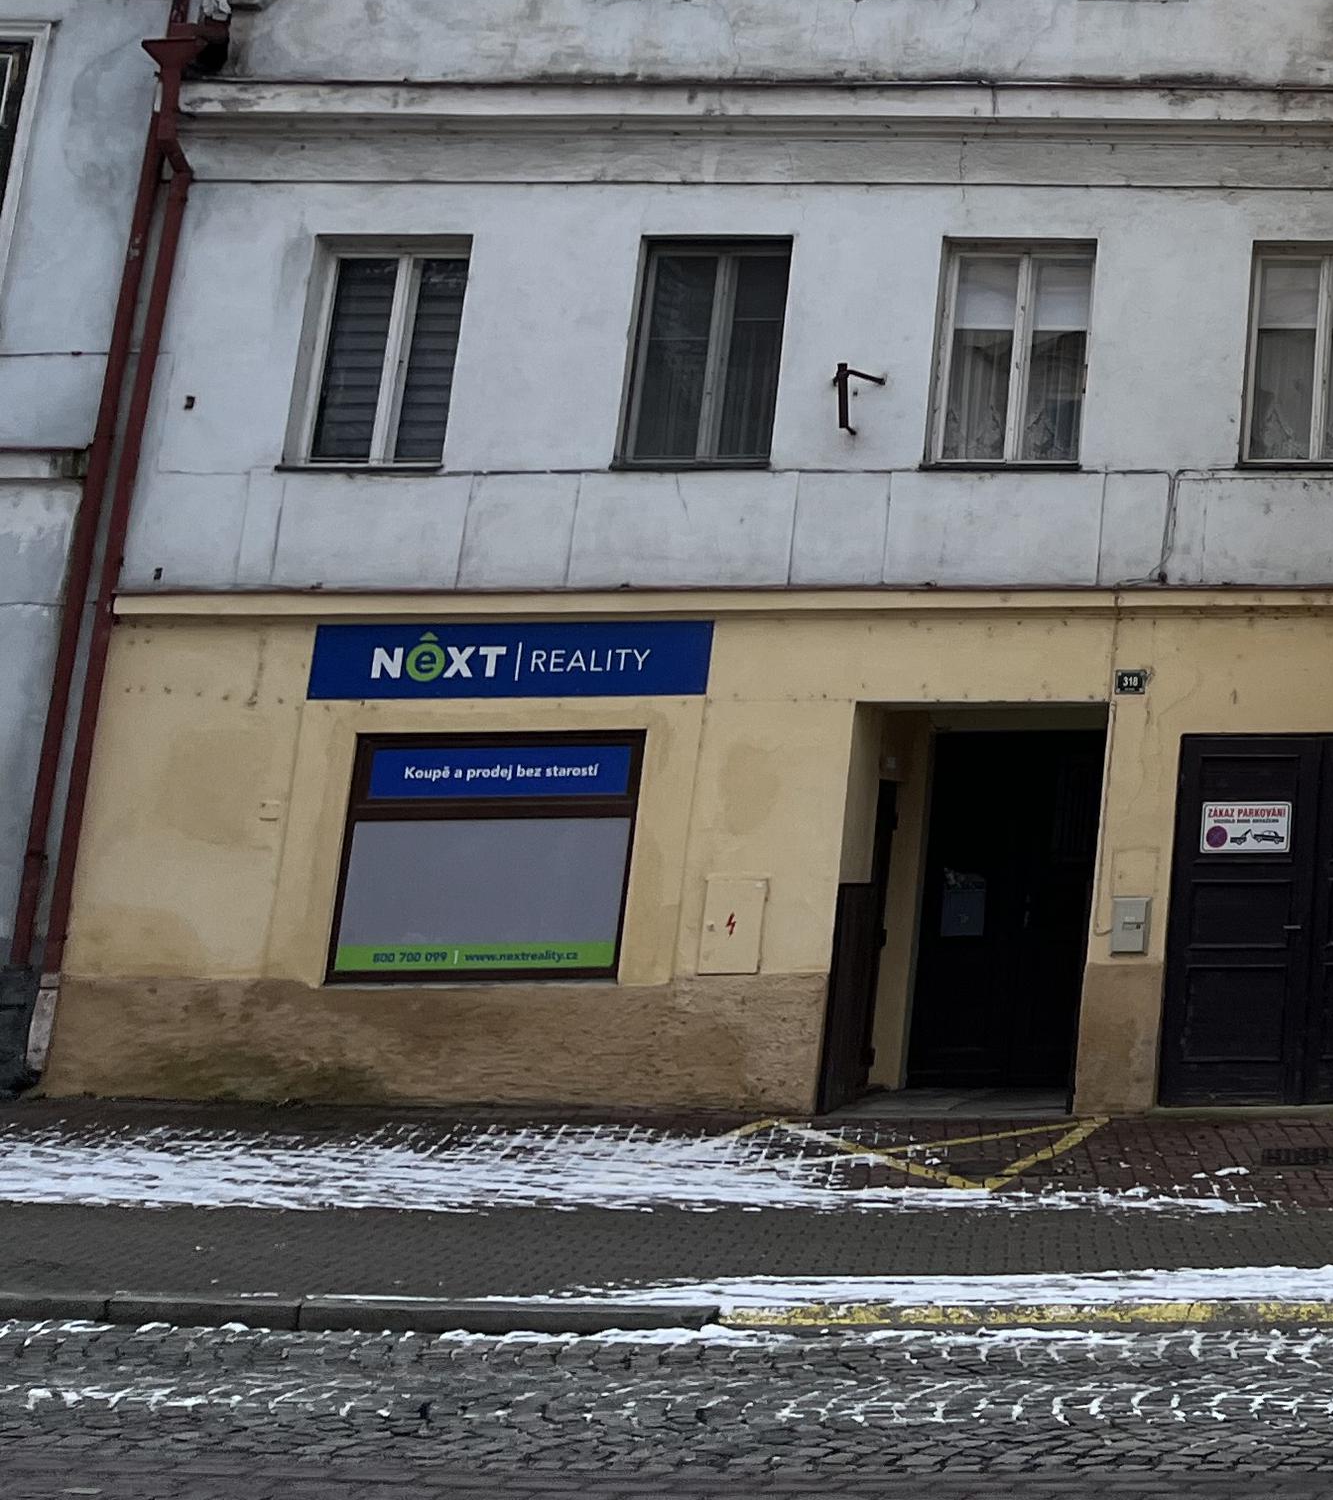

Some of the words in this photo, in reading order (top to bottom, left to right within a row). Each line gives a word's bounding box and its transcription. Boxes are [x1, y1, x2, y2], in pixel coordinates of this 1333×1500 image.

[530, 649, 651, 673] REALITY
[1122, 676, 1139, 687] 318
[404, 766, 450, 782] Koupě
[454, 769, 463, 779] a
[466, 765, 513, 781] prodej
[517, 764, 541, 777] bez
[545, 763, 599, 777] starostí
[399, 952, 422, 962] 700
[464, 949, 579, 962] www.nextreality.cz
